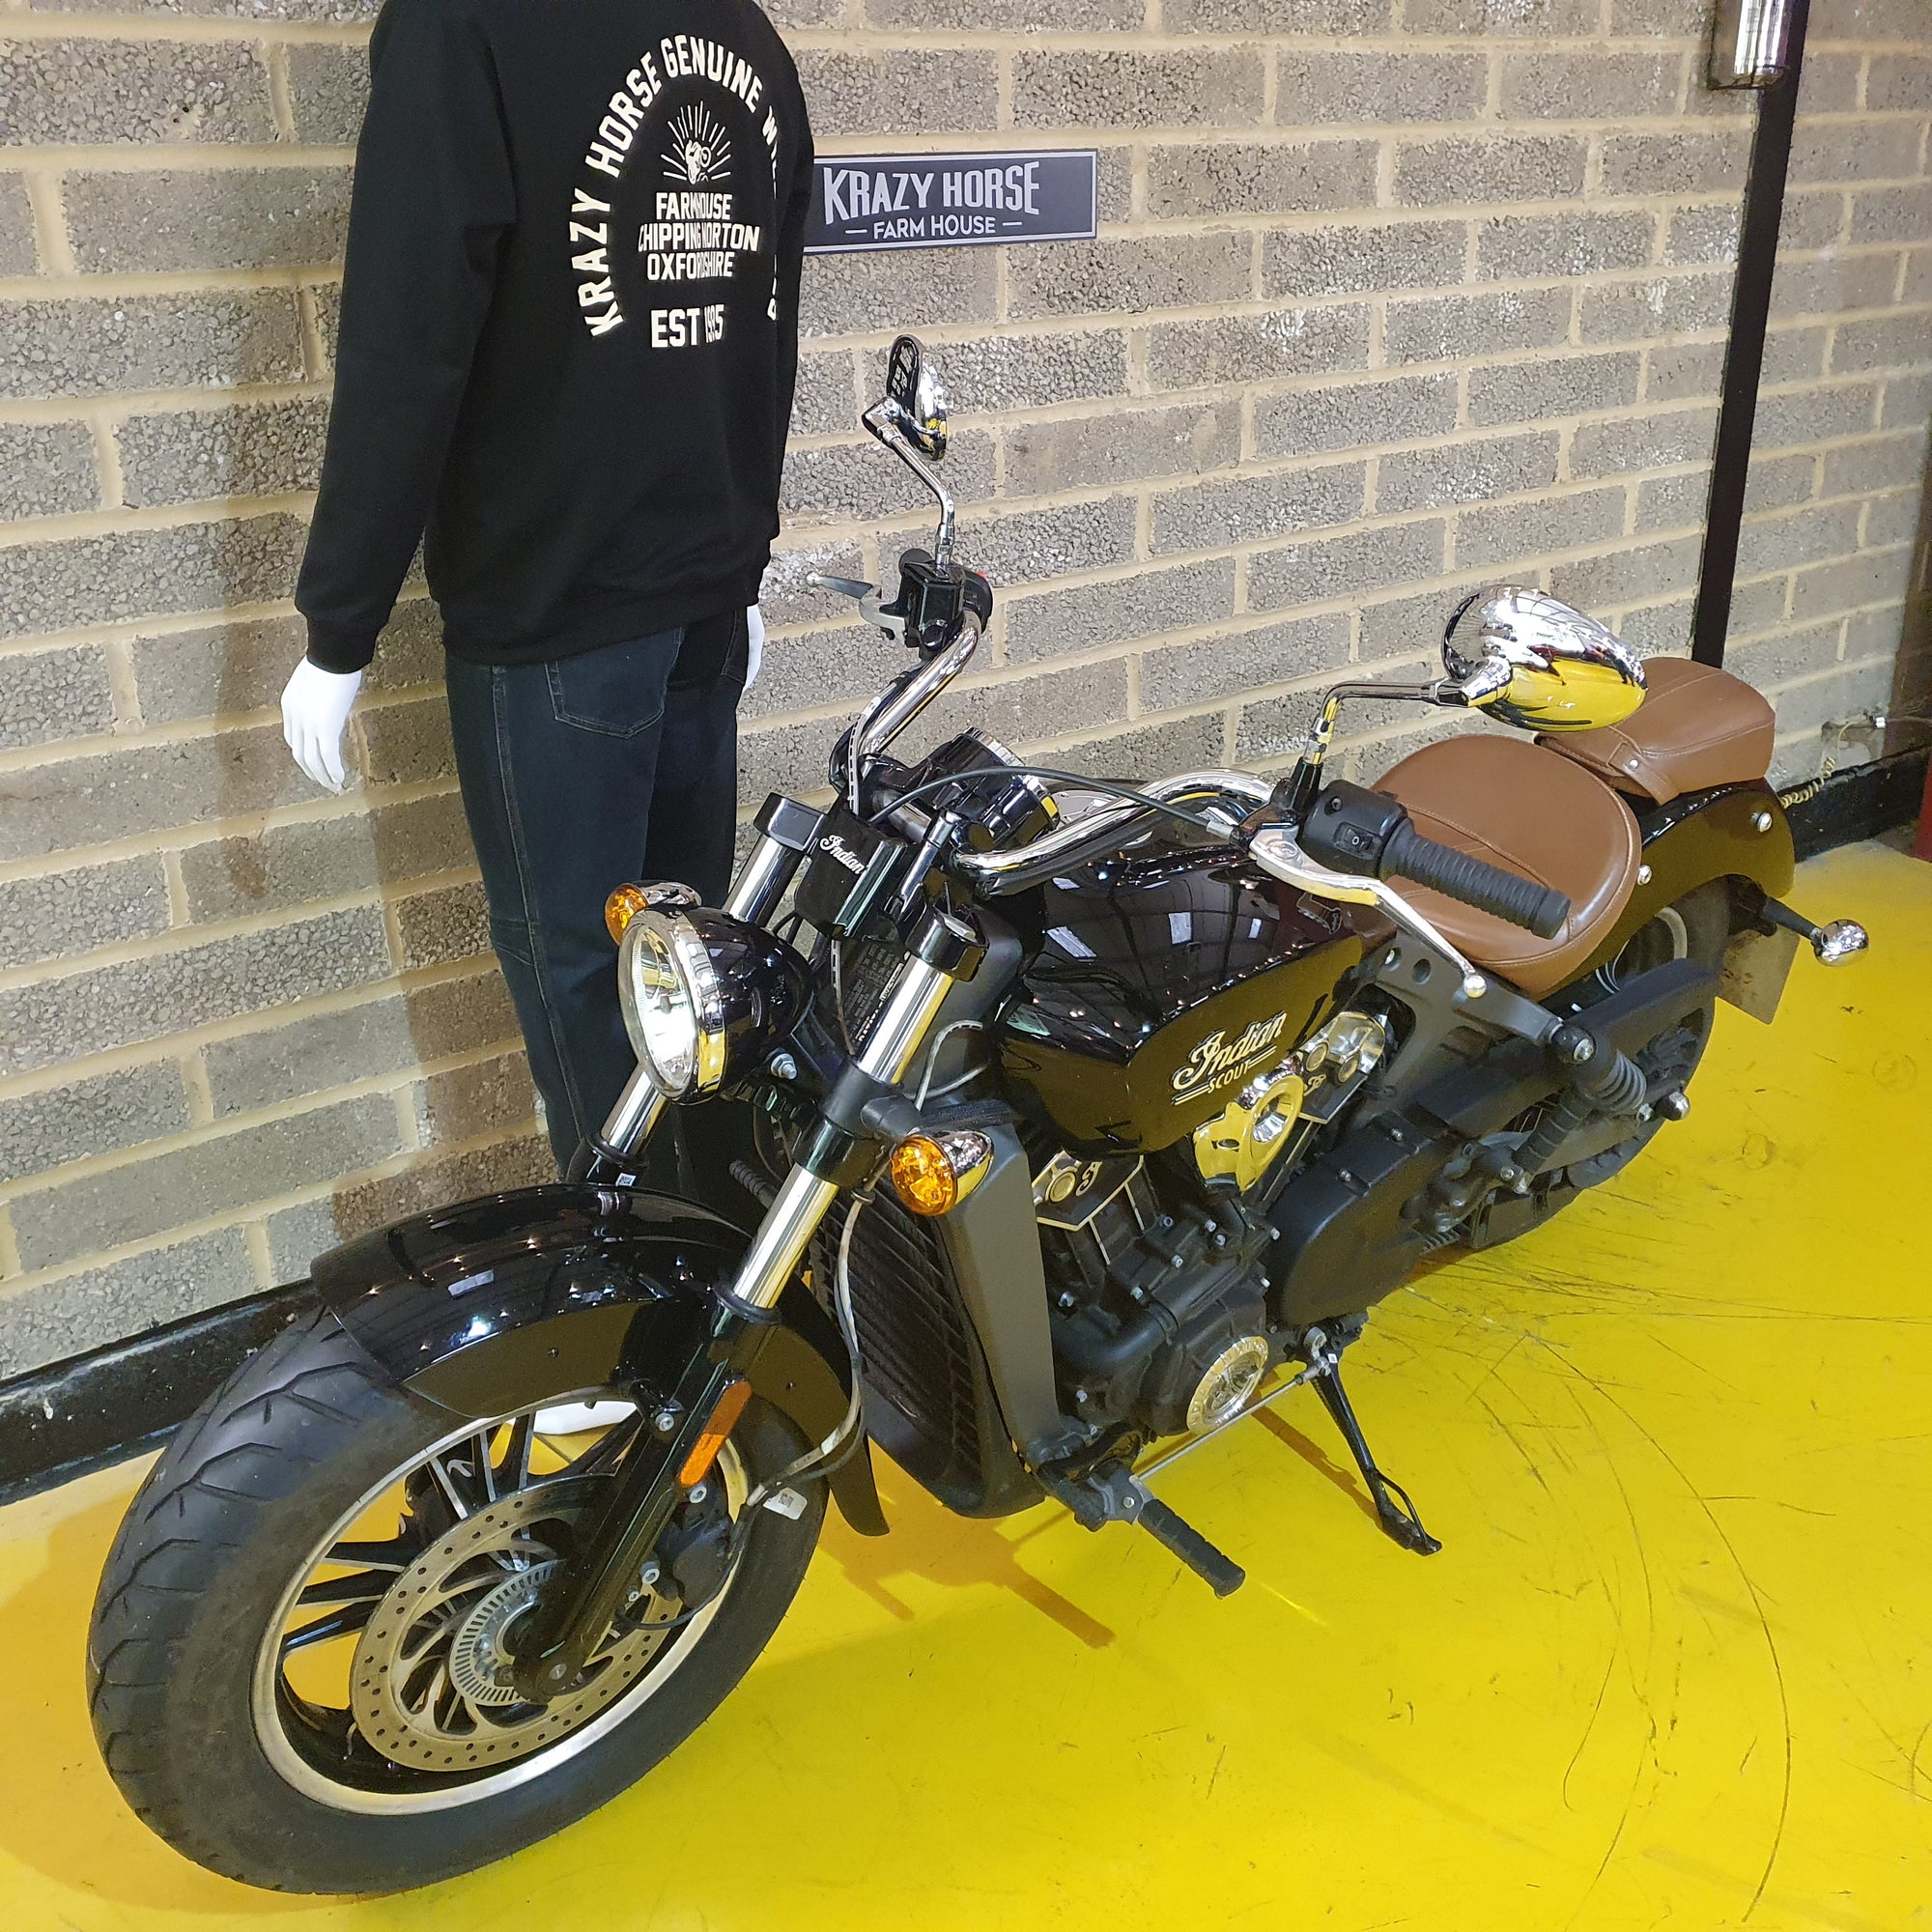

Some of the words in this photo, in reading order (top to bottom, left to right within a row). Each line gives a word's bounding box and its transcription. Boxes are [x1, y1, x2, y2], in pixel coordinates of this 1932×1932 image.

[660, 34, 763, 113] GENUINE
[584, 51, 663, 178] HORSE
[656, 191, 733, 220] FARMOUSE
[824, 166, 935, 225] KRAZY
[942, 160, 1039, 215] HORSE
[638, 222, 701, 253] CHIPPING
[701, 222, 760, 252] NORTON
[873, 217, 924, 240] FARM
[930, 214, 996, 237] HOUSE
[570, 188, 624, 336] KRAZY
[650, 307, 700, 349] EST
[819, 835, 866, 875] Indian
[1172, 1010, 1288, 1091] Indian
[1208, 1060, 1250, 1094] SCOUT
